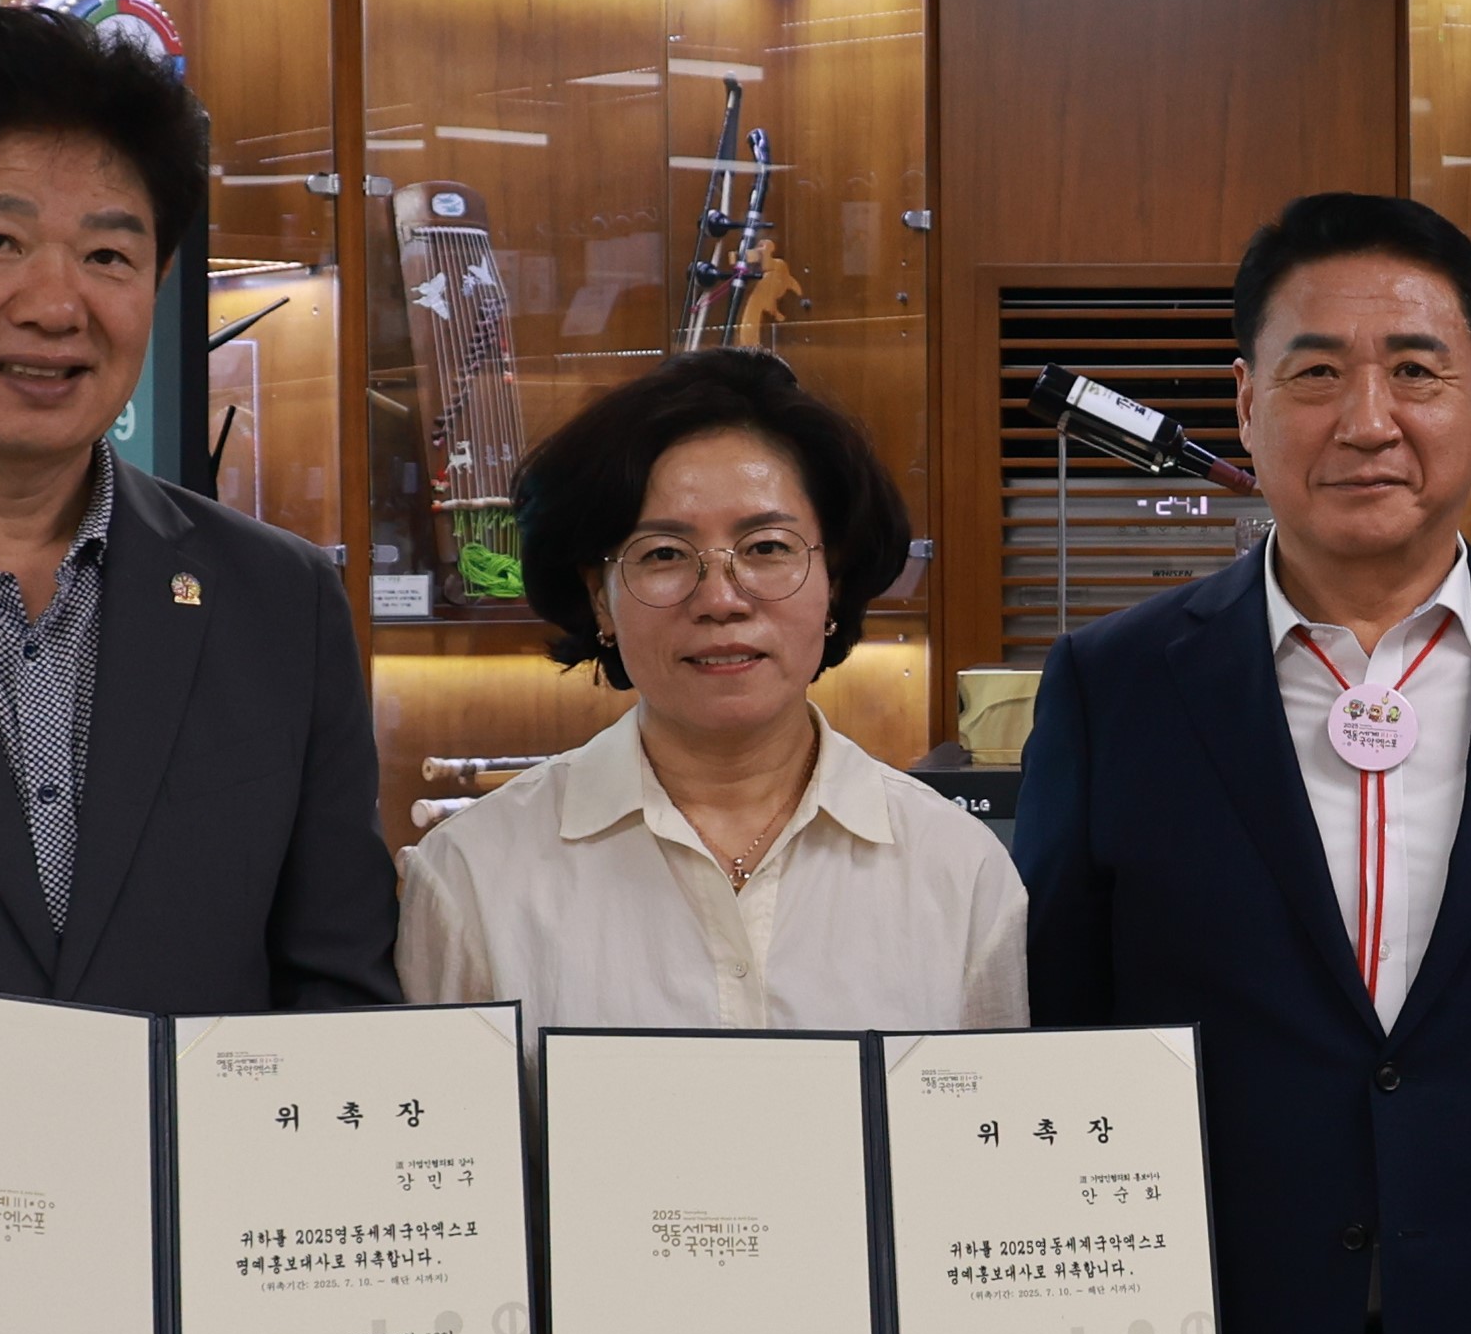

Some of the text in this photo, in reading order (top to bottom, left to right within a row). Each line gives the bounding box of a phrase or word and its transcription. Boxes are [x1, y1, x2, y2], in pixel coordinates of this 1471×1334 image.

[970, 798, 991, 812] LG
[275, 1099, 425, 1131] 위 촉 장
[977, 1117, 1113, 1148] 위 촉 장
[397, 1170, 475, 1191] 강 민 구
[1081, 1184, 1162, 1205] 안 순 화
[652, 1210, 681, 1220] 2025
[240, 1221, 479, 1248] 귀하를 2025영동세계국악엑스포
[950, 1234, 1167, 1259] 귀하를 2025영동세계국악엑스포
[236, 1248, 442, 1276] 명예홍보대사로 위촉합니다.
[947, 1259, 1134, 1285] 명예홍보대사로 위촉합니다.
